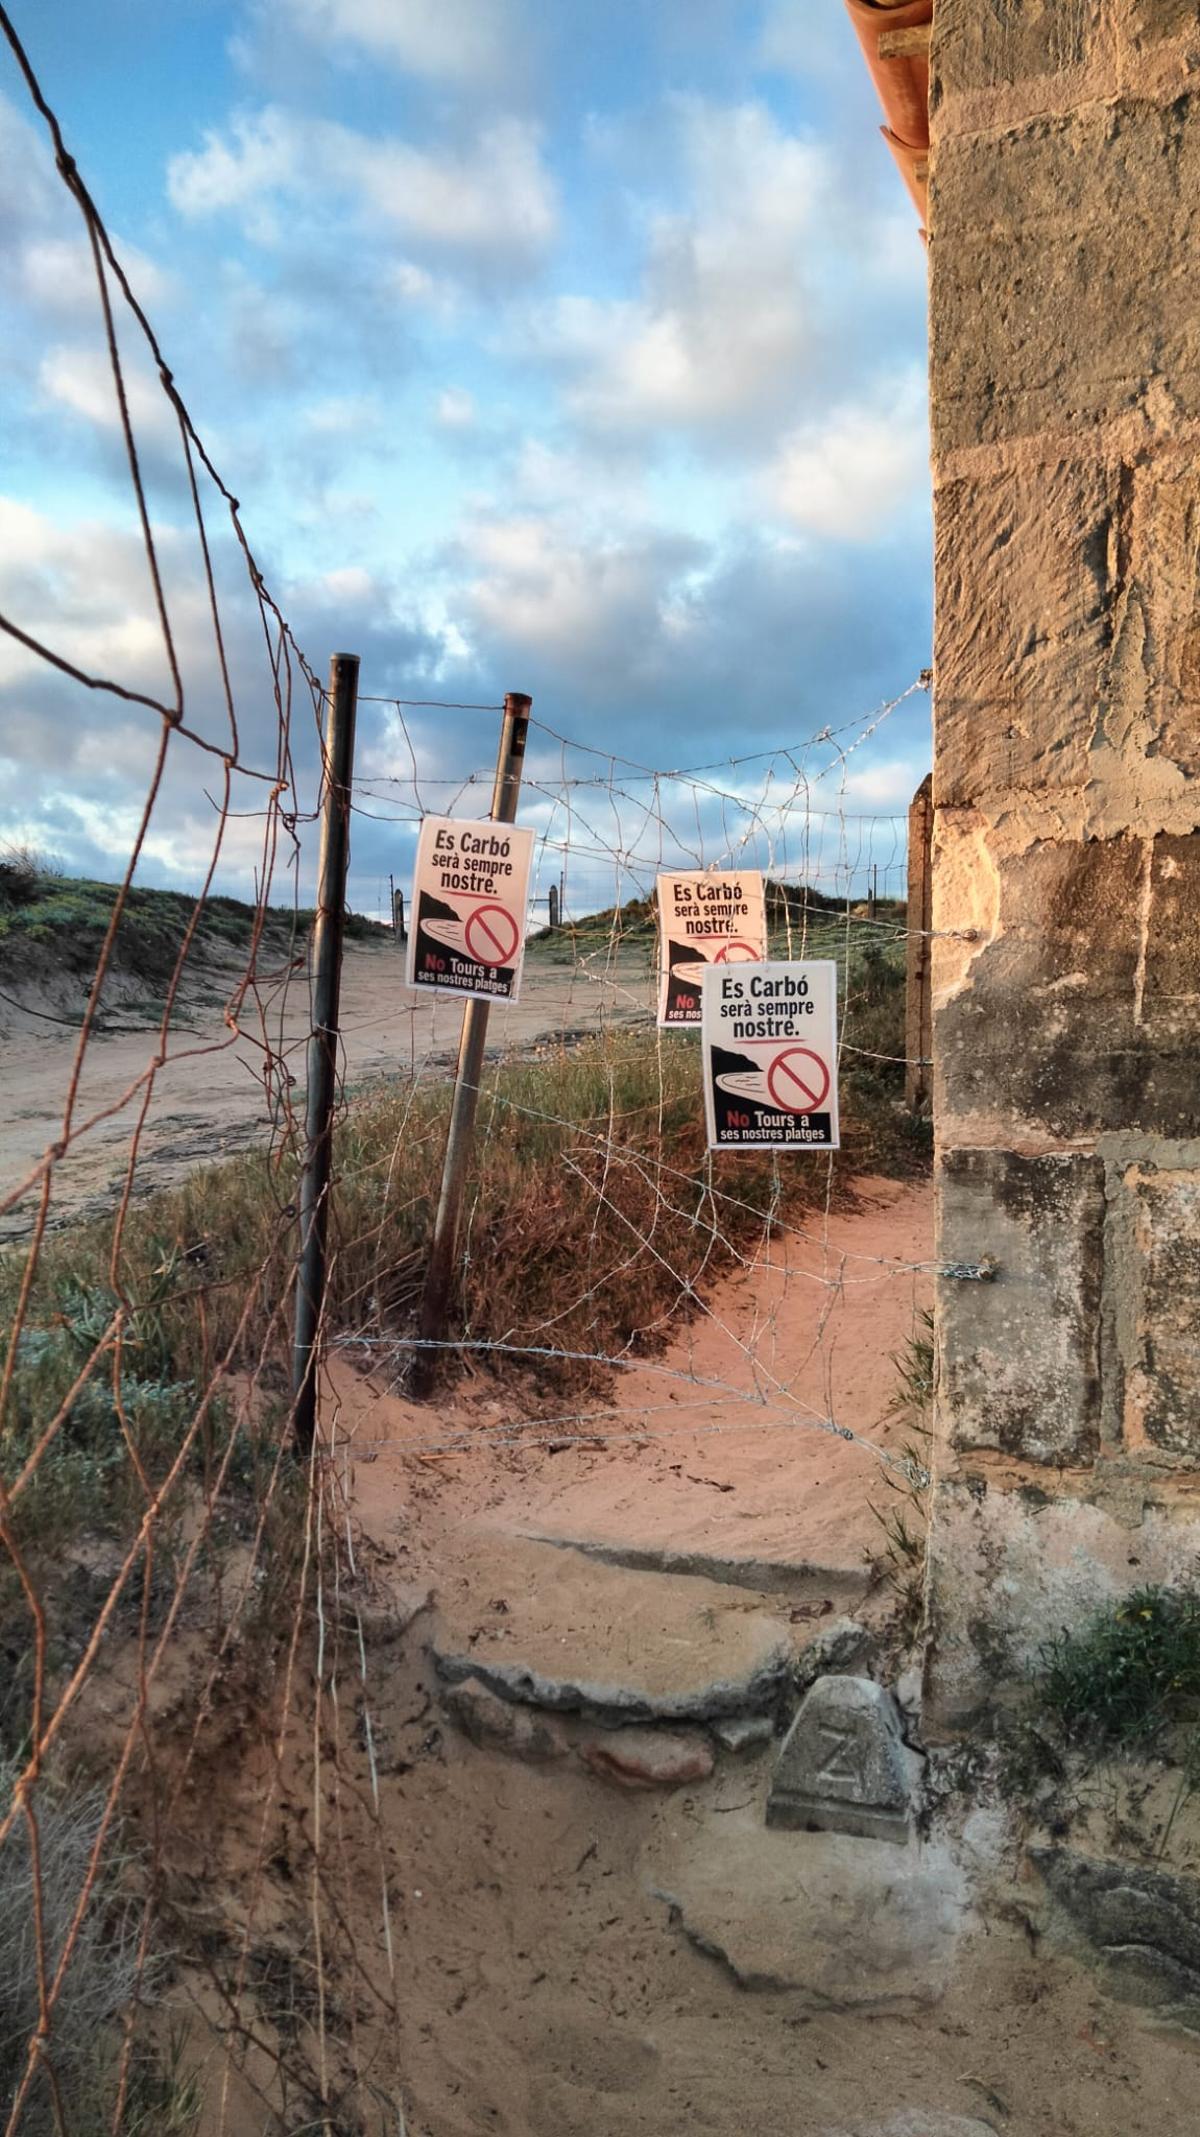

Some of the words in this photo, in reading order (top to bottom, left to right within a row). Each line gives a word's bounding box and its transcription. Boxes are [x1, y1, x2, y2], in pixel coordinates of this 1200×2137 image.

[435, 829, 455, 850] Es
[460, 831, 511, 857] Carbó
[431, 852, 460, 869] serà
[463, 857, 513, 877] sempre
[440, 872, 498, 894] nostre.
[673, 884, 692, 901] Es
[696, 881, 743, 901] Carbó
[674, 902, 700, 917] serà
[686, 917, 738, 934] nostre.
[425, 954, 445, 971] No
[450, 958, 485, 977] Tours
[489, 967, 498, 979] a
[417, 970, 435, 982] ses
[437, 973, 473, 988] nostres
[474, 978, 508, 994] platges
[721, 978, 744, 999] Es
[750, 974, 809, 997] Carbó
[676, 994, 695, 1009] No
[720, 1000, 752, 1018] serà
[757, 1000, 814, 1020] sempre
[668, 1010, 685, 1019] ses
[733, 1017, 800, 1038] nostre.
[726, 1110, 750, 1128] No
[754, 1111, 795, 1127] Tours
[800, 1115, 809, 1127] a
[720, 1128, 740, 1140] ses
[742, 1128, 783, 1140] nostres
[785, 1127, 825, 1143] platges
